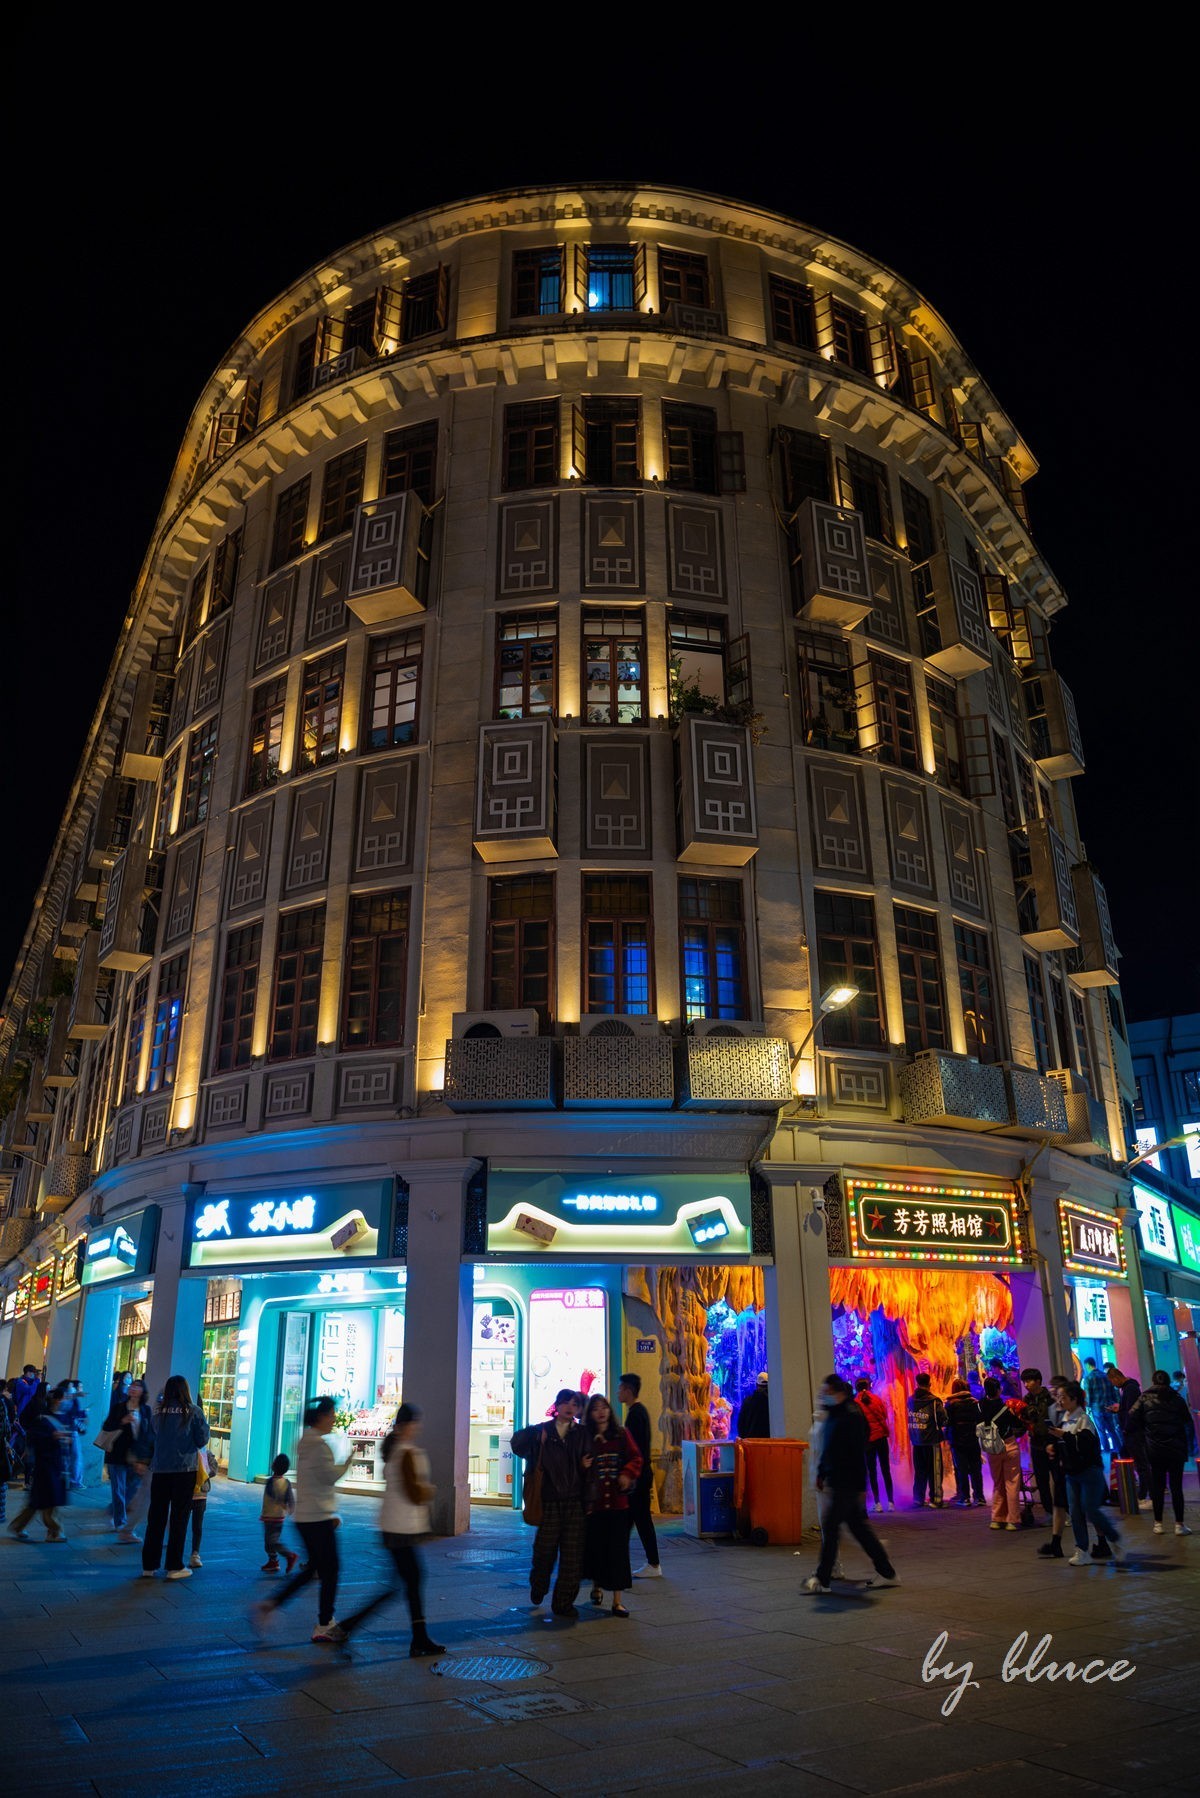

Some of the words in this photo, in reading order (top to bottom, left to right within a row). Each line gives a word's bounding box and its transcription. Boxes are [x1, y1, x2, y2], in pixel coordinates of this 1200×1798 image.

[893, 1208, 984, 1239] 芳芳照相馆
